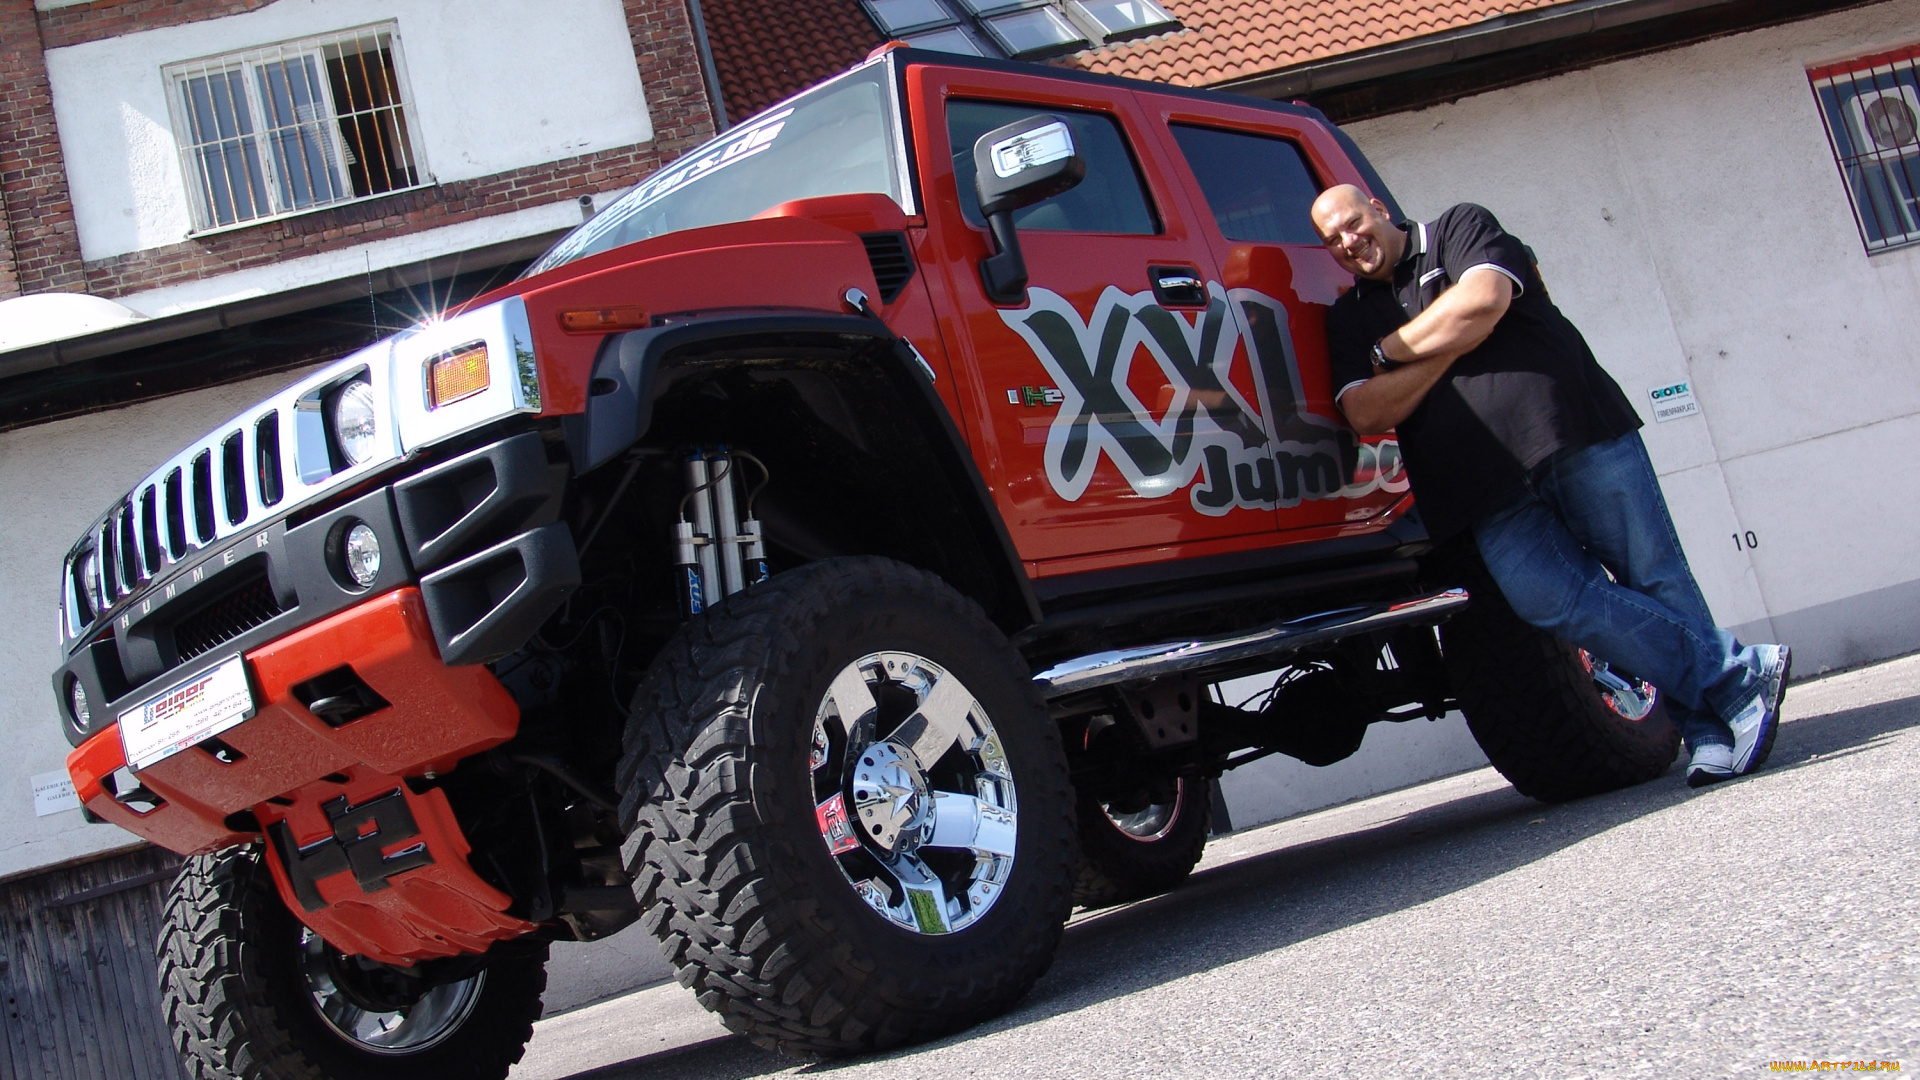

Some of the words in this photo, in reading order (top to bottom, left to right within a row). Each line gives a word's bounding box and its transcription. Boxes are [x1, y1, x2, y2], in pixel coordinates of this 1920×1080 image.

[999, 284, 1352, 499] XXL
[1021, 386, 1064, 407] H2
[1651, 383, 1688, 399] GEOTEX
[1732, 530, 1758, 551] 10
[120, 531, 270, 630] HUMMER
[687, 567, 704, 615] FOX
[35, 783, 59, 792] GALERIE
[47, 792, 71, 801] GALERIE
